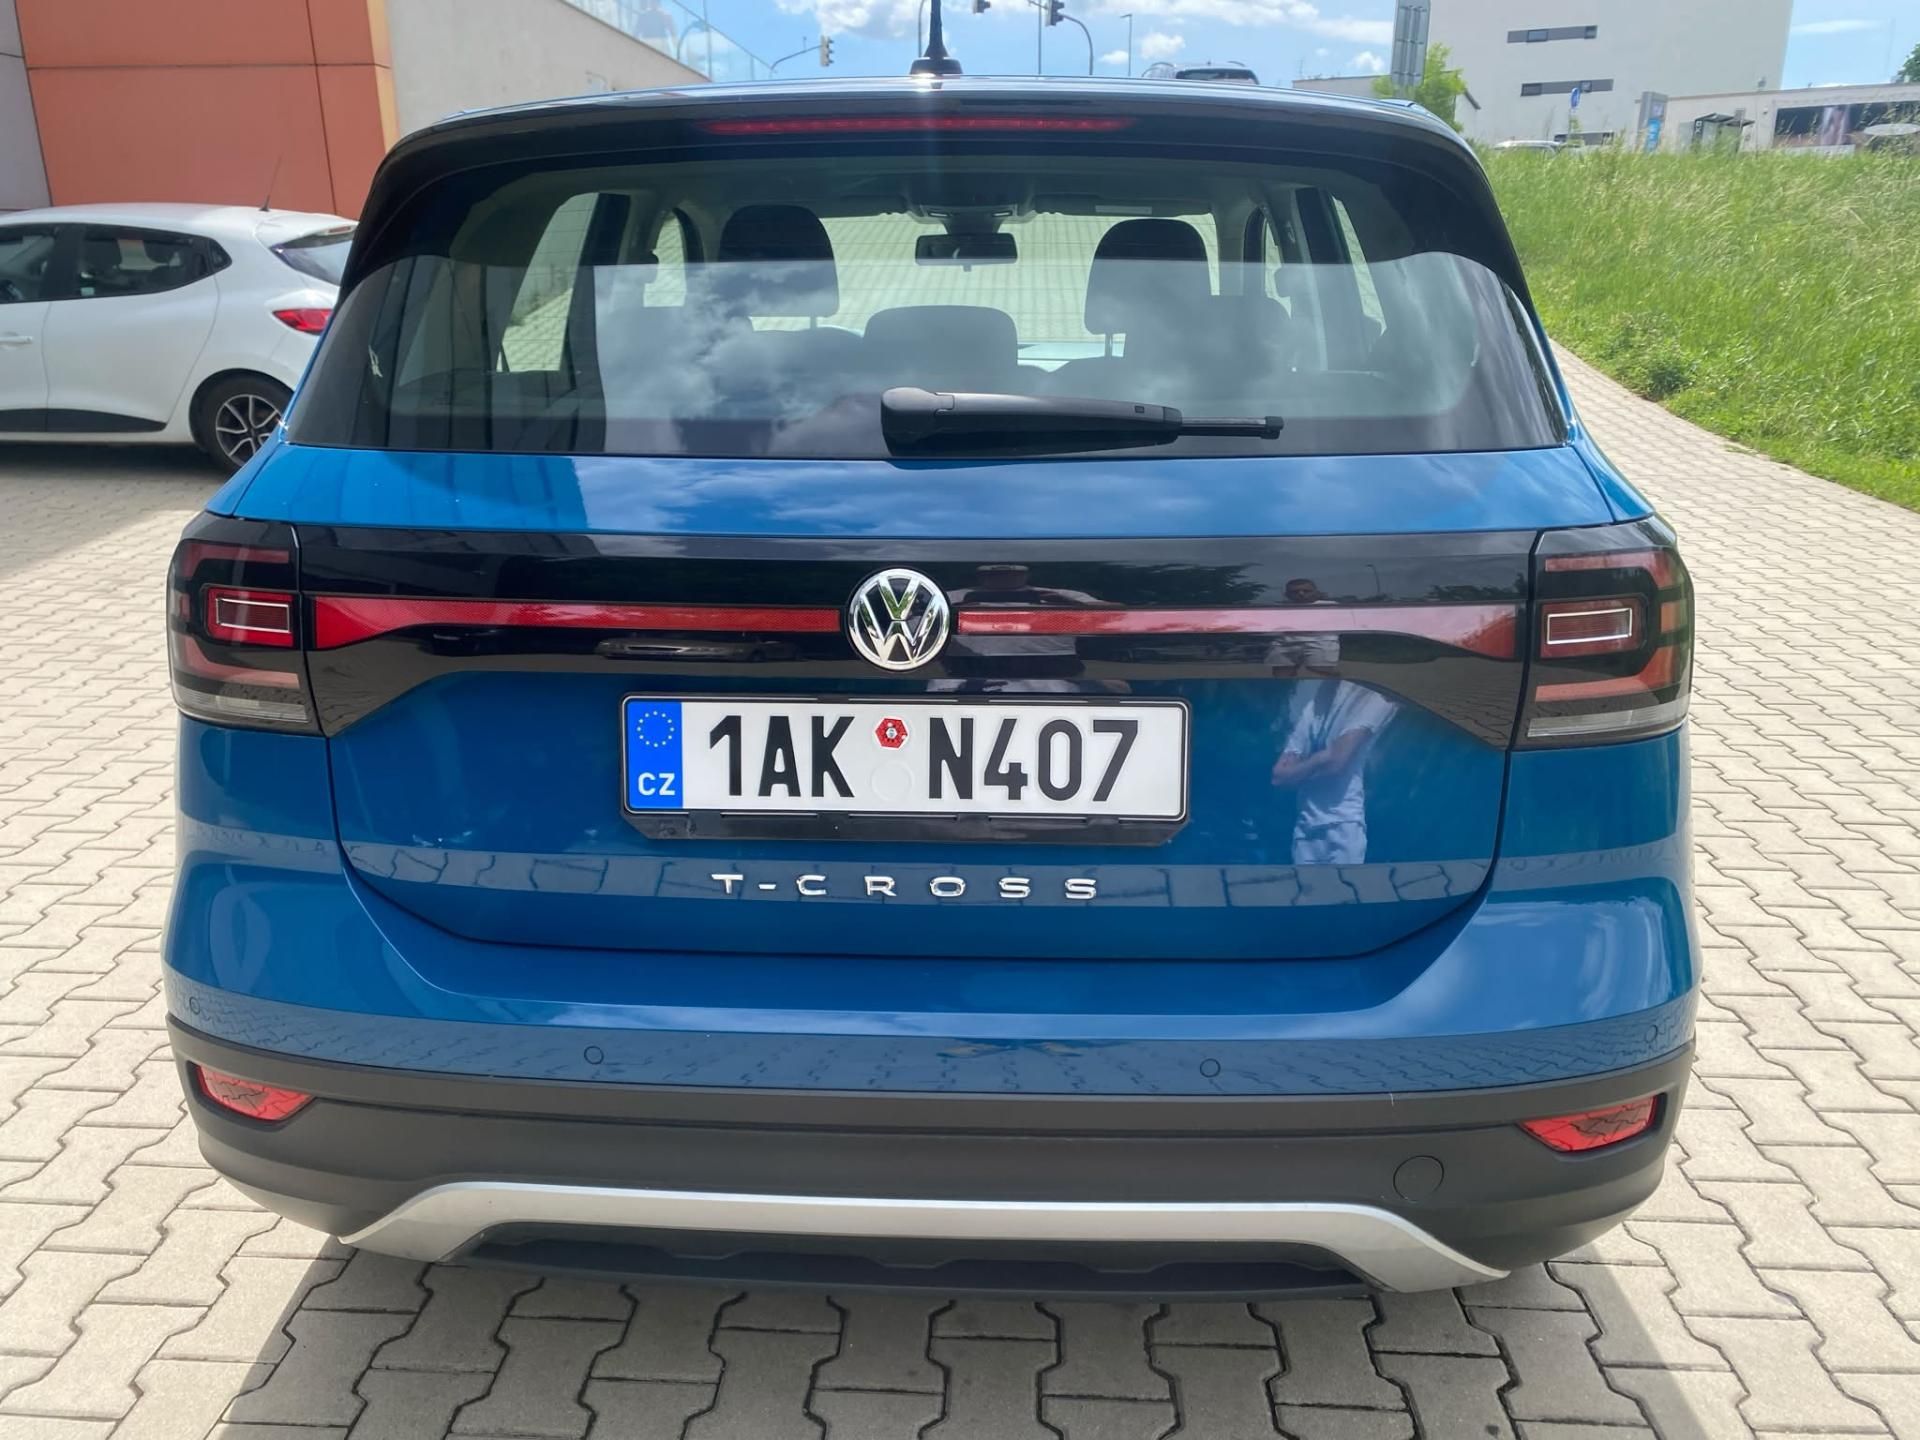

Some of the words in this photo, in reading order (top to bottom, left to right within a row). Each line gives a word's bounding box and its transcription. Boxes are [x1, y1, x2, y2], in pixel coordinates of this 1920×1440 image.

[709, 714, 856, 798] 1AK
[928, 717, 1140, 802] N407
[637, 772, 676, 796] CZ
[711, 872, 1098, 899] T-CROSS
